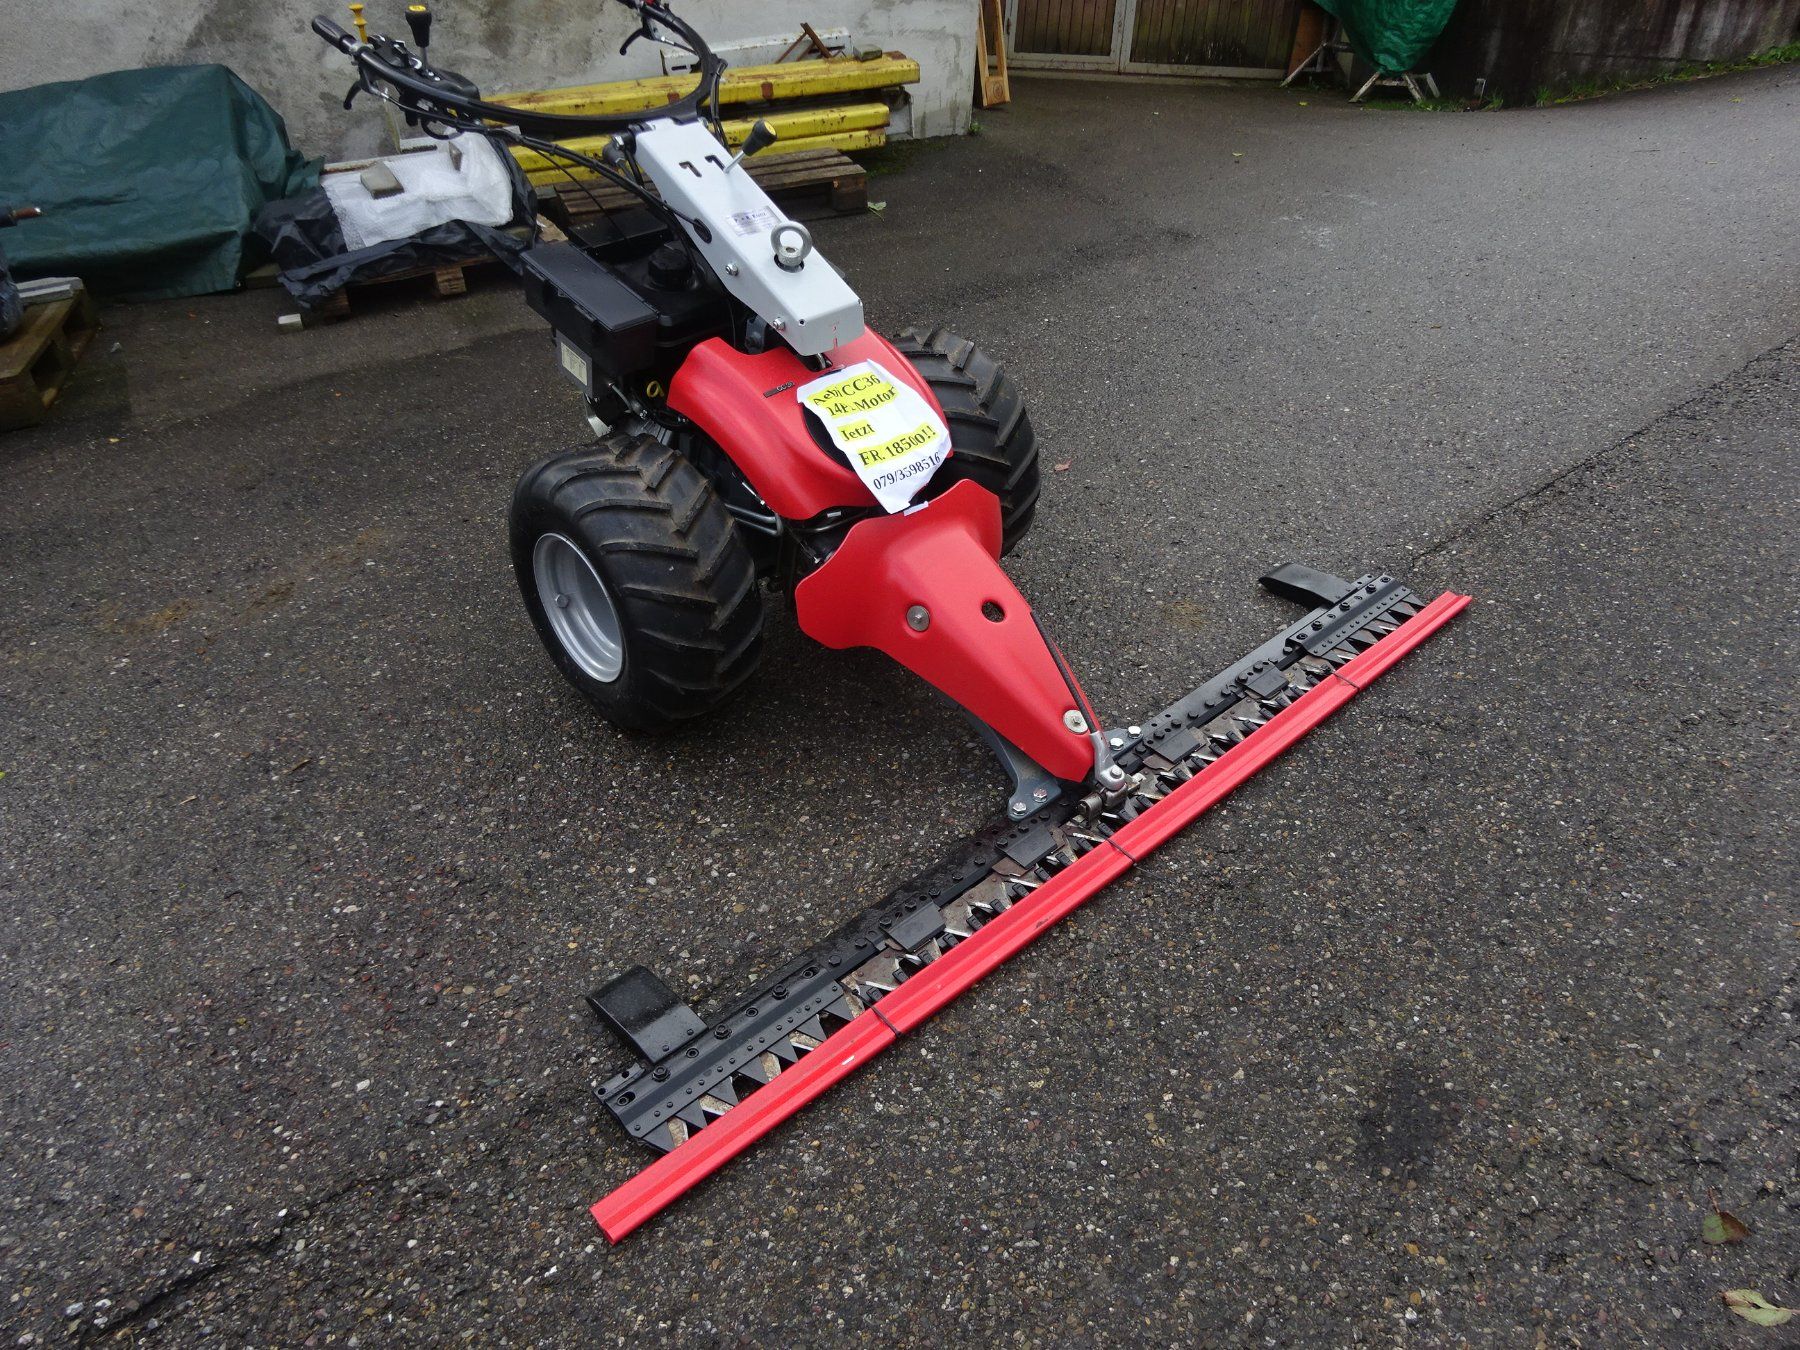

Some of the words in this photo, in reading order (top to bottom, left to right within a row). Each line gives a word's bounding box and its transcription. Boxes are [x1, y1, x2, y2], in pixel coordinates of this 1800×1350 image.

[841, 423, 875, 441] Jetzt
[858, 449, 885, 466] FR.
[873, 451, 940, 490] 079/3598516
